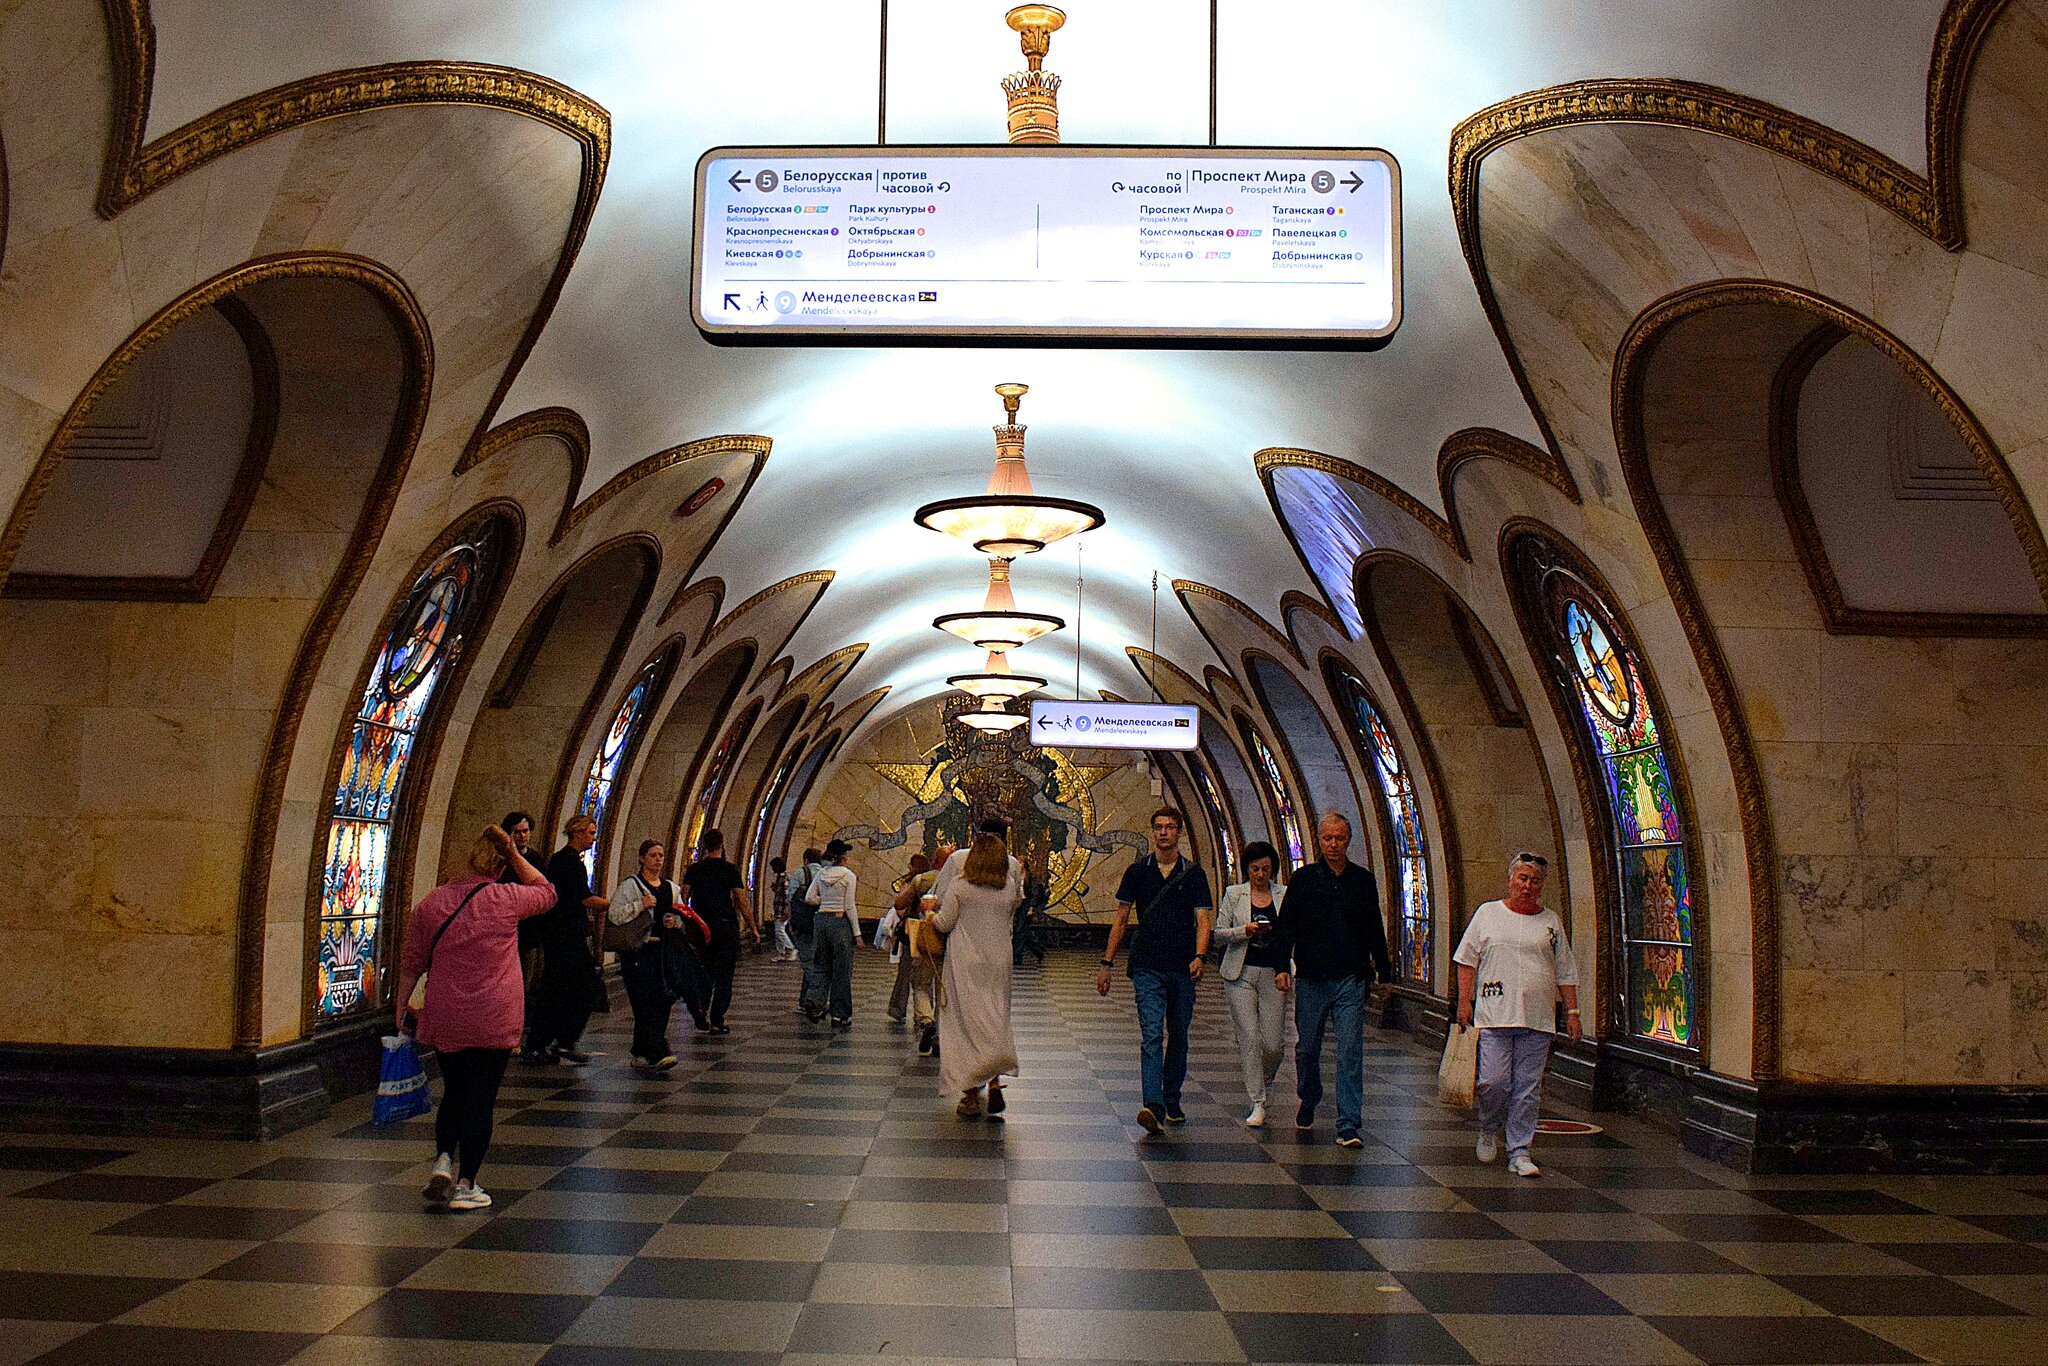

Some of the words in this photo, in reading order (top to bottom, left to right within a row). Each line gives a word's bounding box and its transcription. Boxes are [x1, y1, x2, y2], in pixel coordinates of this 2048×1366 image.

[762, 174, 772, 188] 5
[784, 170, 872, 184] Белорусская
[883, 172, 927, 183] против
[1166, 173, 1182, 182] по
[1192, 170, 1261, 184] Проспект
[1264, 170, 1306, 185] Мира
[1318, 176, 1328, 188] 5
[784, 185, 841, 194] Belorusskaya
[882, 184, 933, 193] часовой
[1128, 184, 1182, 194] часовой
[1241, 185, 1281, 195] Prospekt
[1284, 185, 1306, 194] Mira
[727, 205, 792, 215] Белорусская
[849, 205, 875, 214] Парк
[878, 206, 925, 215] культуры
[1140, 205, 1190, 215] Проспект
[1193, 205, 1223, 215] Мира
[1272, 206, 1324, 214] Таганская
[726, 227, 829, 237] Краснопресненская
[848, 227, 915, 236] Октябрьская
[1140, 228, 1224, 236] Комсомольская
[1273, 228, 1337, 238] Павелецкая
[848, 249, 925, 259] Добрынинская
[1140, 250, 1183, 260] Курская
[1272, 251, 1352, 261] Добрынинская
[802, 291, 916, 303] Менделеевская
[1094, 716, 1173, 727] Менделеевская
[1094, 727, 1147, 735] Mendeleevskaya
